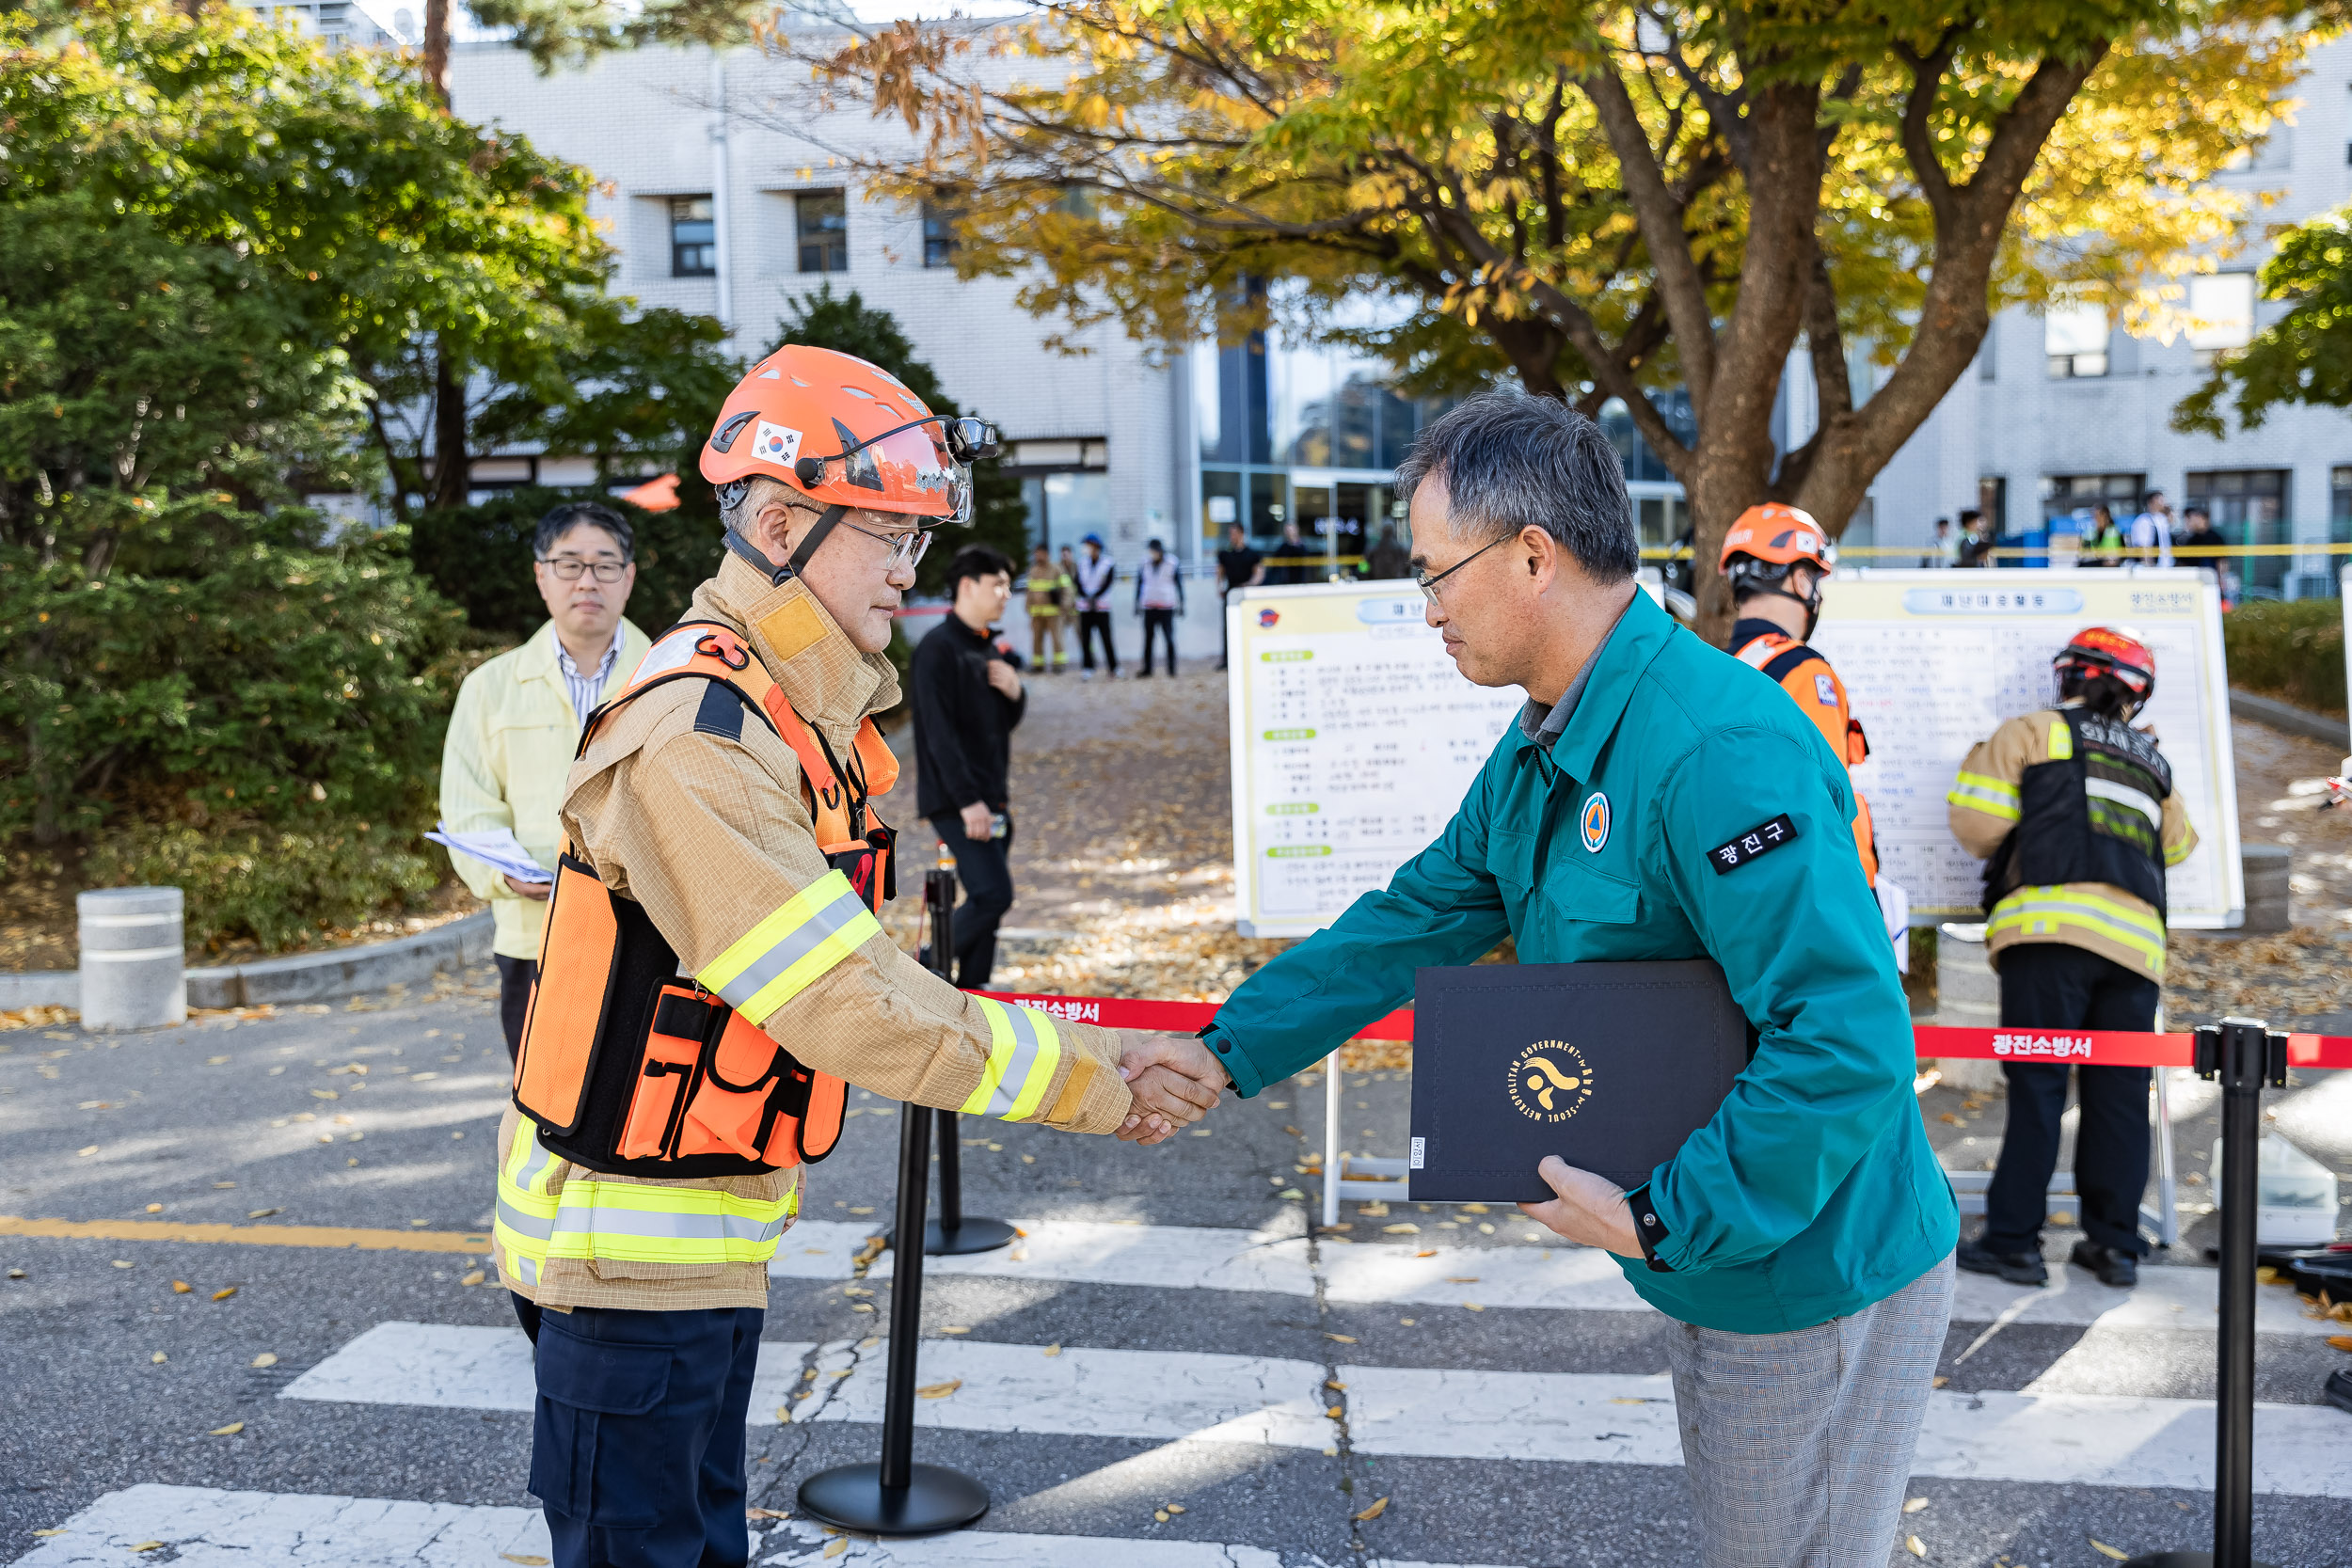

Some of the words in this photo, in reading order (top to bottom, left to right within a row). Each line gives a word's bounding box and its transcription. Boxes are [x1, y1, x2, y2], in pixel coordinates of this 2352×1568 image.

[1718, 821, 1785, 864] 광진구
[1520, 1039, 1581, 1059] GOVERNMENT
[1992, 1033, 2092, 1058] 광진소방서
[1507, 1060, 1542, 1121] METROPOLITAN
[1548, 1107, 1577, 1123] SEOUL
